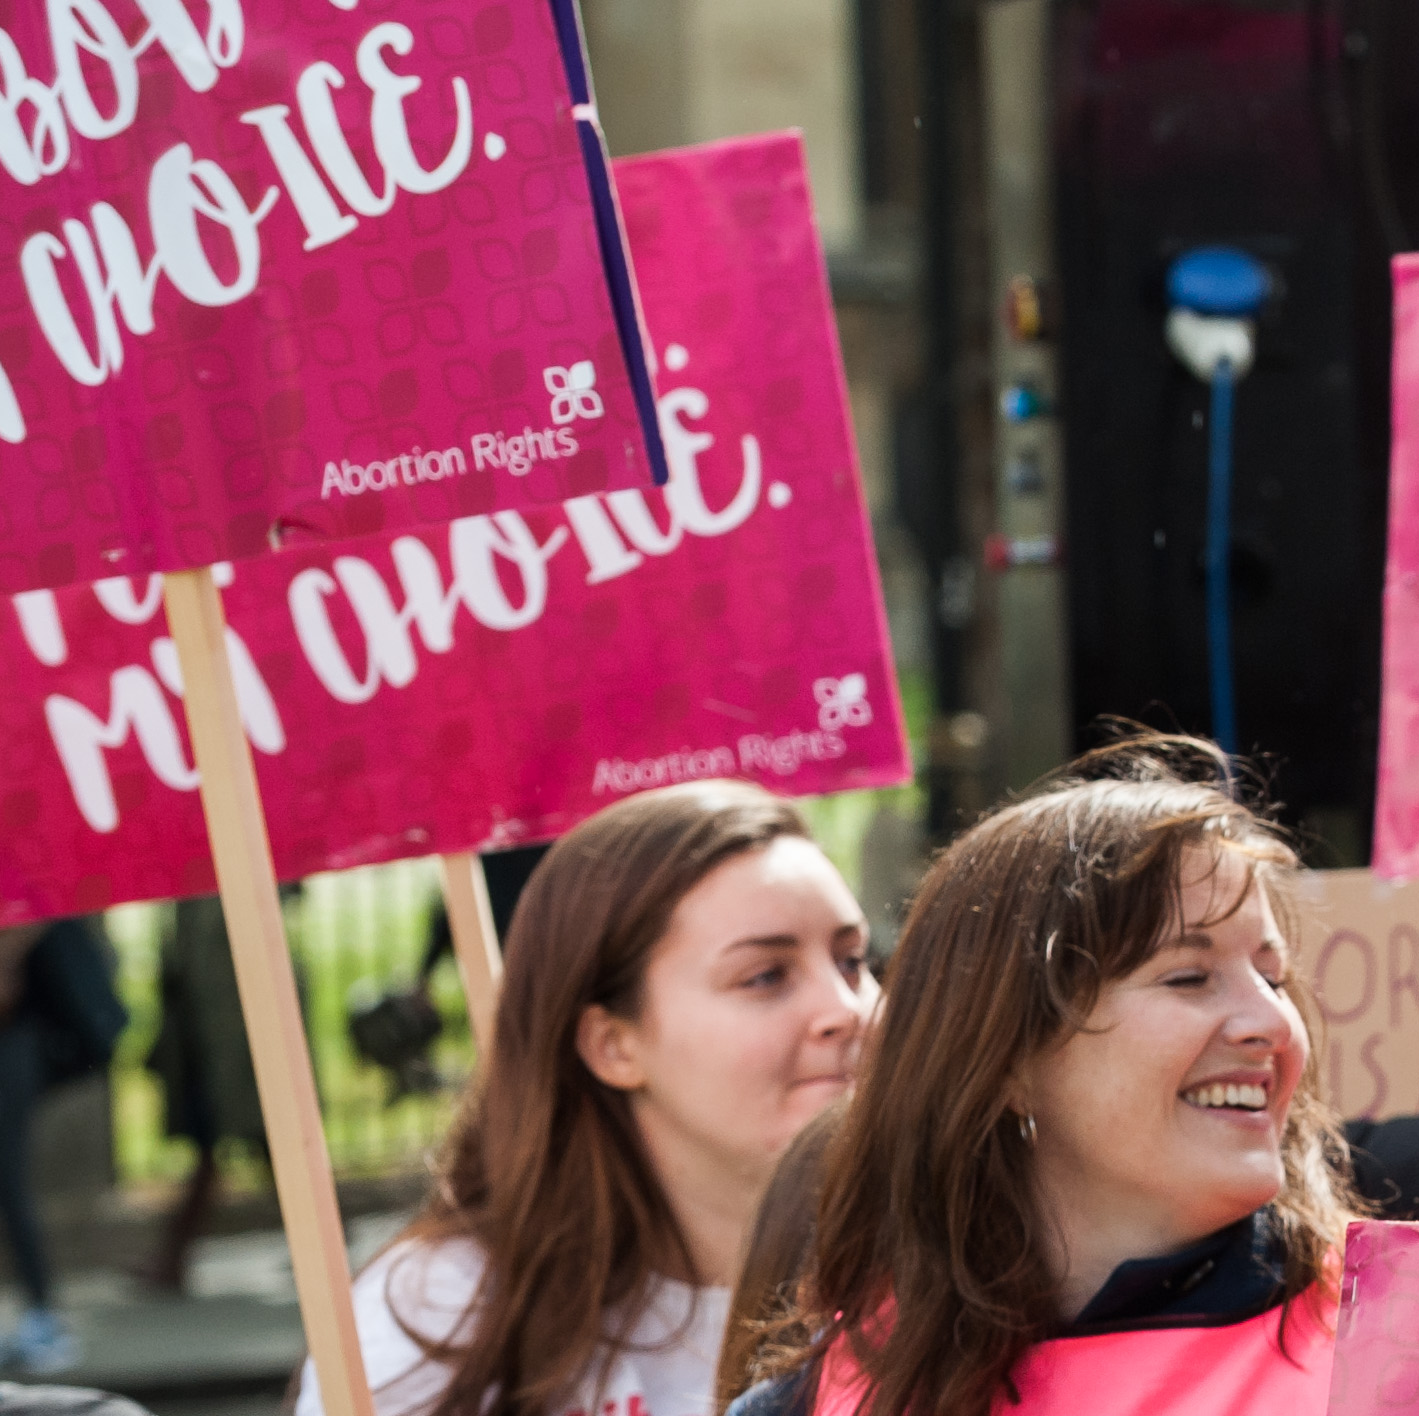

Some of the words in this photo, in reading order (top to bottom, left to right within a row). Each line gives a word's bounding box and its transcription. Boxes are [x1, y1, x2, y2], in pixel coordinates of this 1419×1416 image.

[20, 22, 508, 387] CHOICE.
[319, 445, 467, 501] Abortion
[470, 425, 580, 477] Rights
